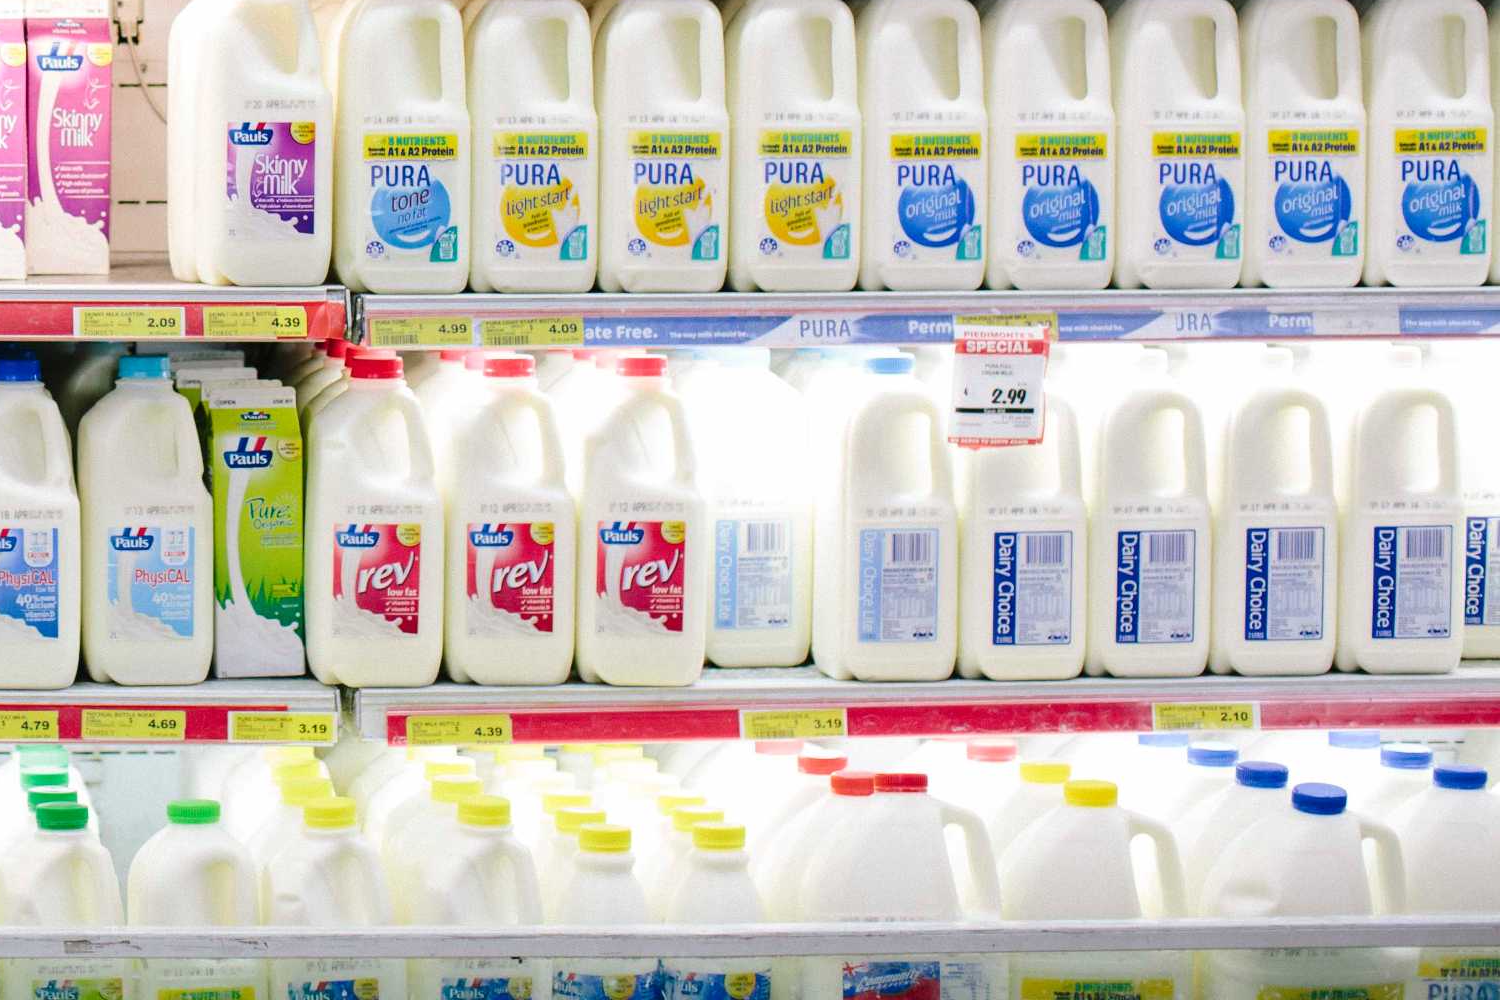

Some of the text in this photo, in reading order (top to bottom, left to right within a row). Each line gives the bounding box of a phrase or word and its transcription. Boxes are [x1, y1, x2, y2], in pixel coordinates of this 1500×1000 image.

[53, 108, 103, 134] Skinny
[60, 126, 95, 149] Milk
[1022, 166, 1080, 188] PURA
[392, 189, 429, 212] tone
[506, 188, 571, 219] light start
[906, 188, 960, 218] original
[147, 317, 177, 329] 2.09
[271, 317, 301, 329] 4.39
[438, 324, 468, 335] 4.99
[548, 324, 577, 335] 4.09
[966, 341, 1032, 353] SPECIAL
[992, 388, 1027, 404] 2.99
[246, 497, 290, 521] Pure
[622, 549, 677, 592] rev
[995, 535, 1014, 634] Dairy Choice
[1118, 534, 1138, 633] Dairy Choice
[1375, 530, 1394, 628] Dairy Choice
[387, 586, 419, 596] low fat
[652, 586, 682, 595] low fat
[1220, 710, 1248, 723] 2.10
[21, 719, 49, 730] 4.79
[148, 719, 177, 730] 4.69
[299, 723, 327, 734] 3.19
[813, 717, 842, 730] 3.19
[474, 726, 503, 737] 4.39
